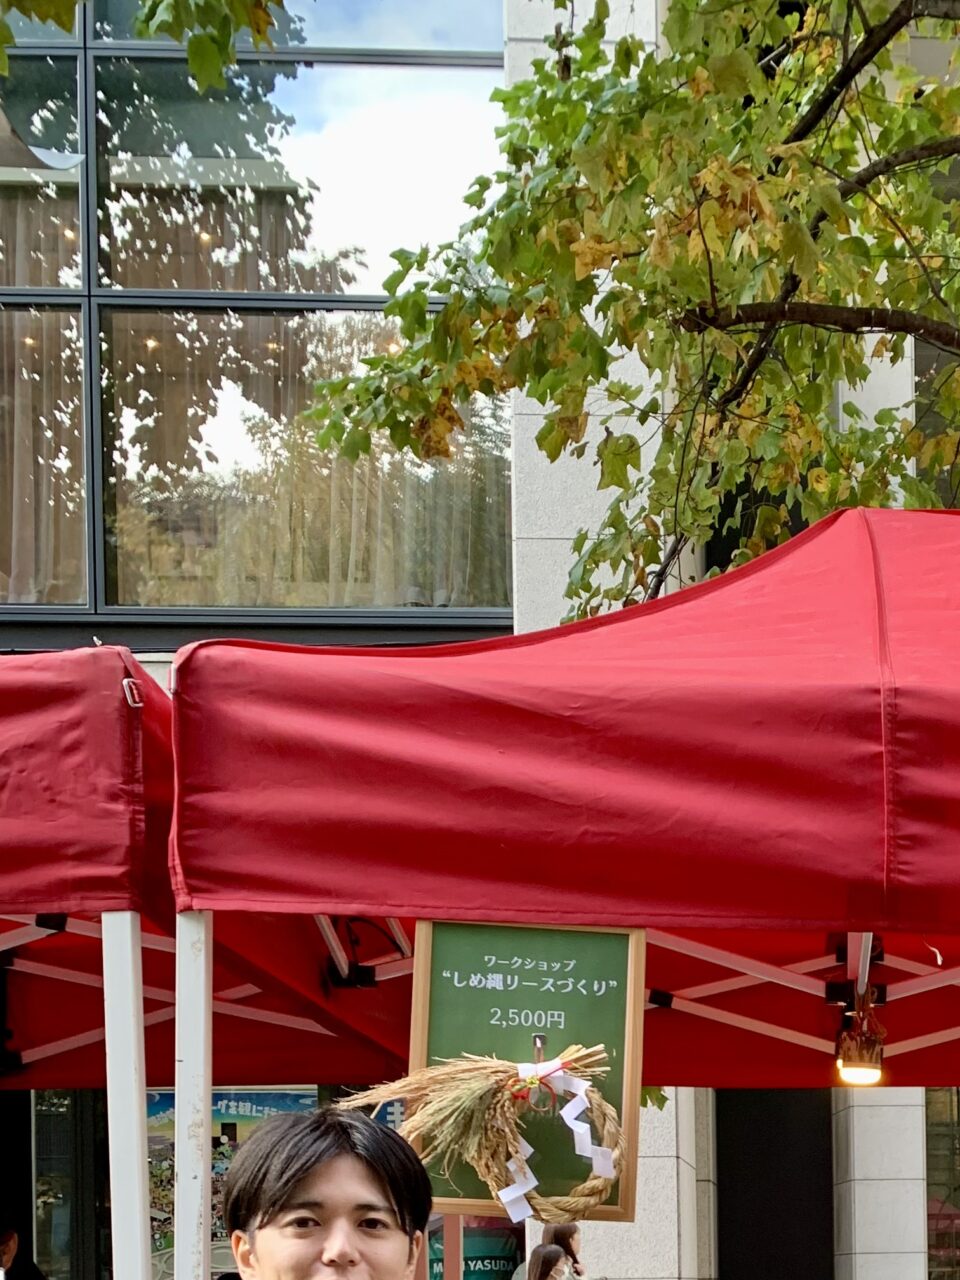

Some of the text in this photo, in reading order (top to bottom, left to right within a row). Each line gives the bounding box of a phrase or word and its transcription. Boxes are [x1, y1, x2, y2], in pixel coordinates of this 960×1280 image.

[483, 953, 577, 972] ワークショップ
[489, 1007, 566, 1031] 2,500円
[468, 1259, 514, 1272] YASUDA
